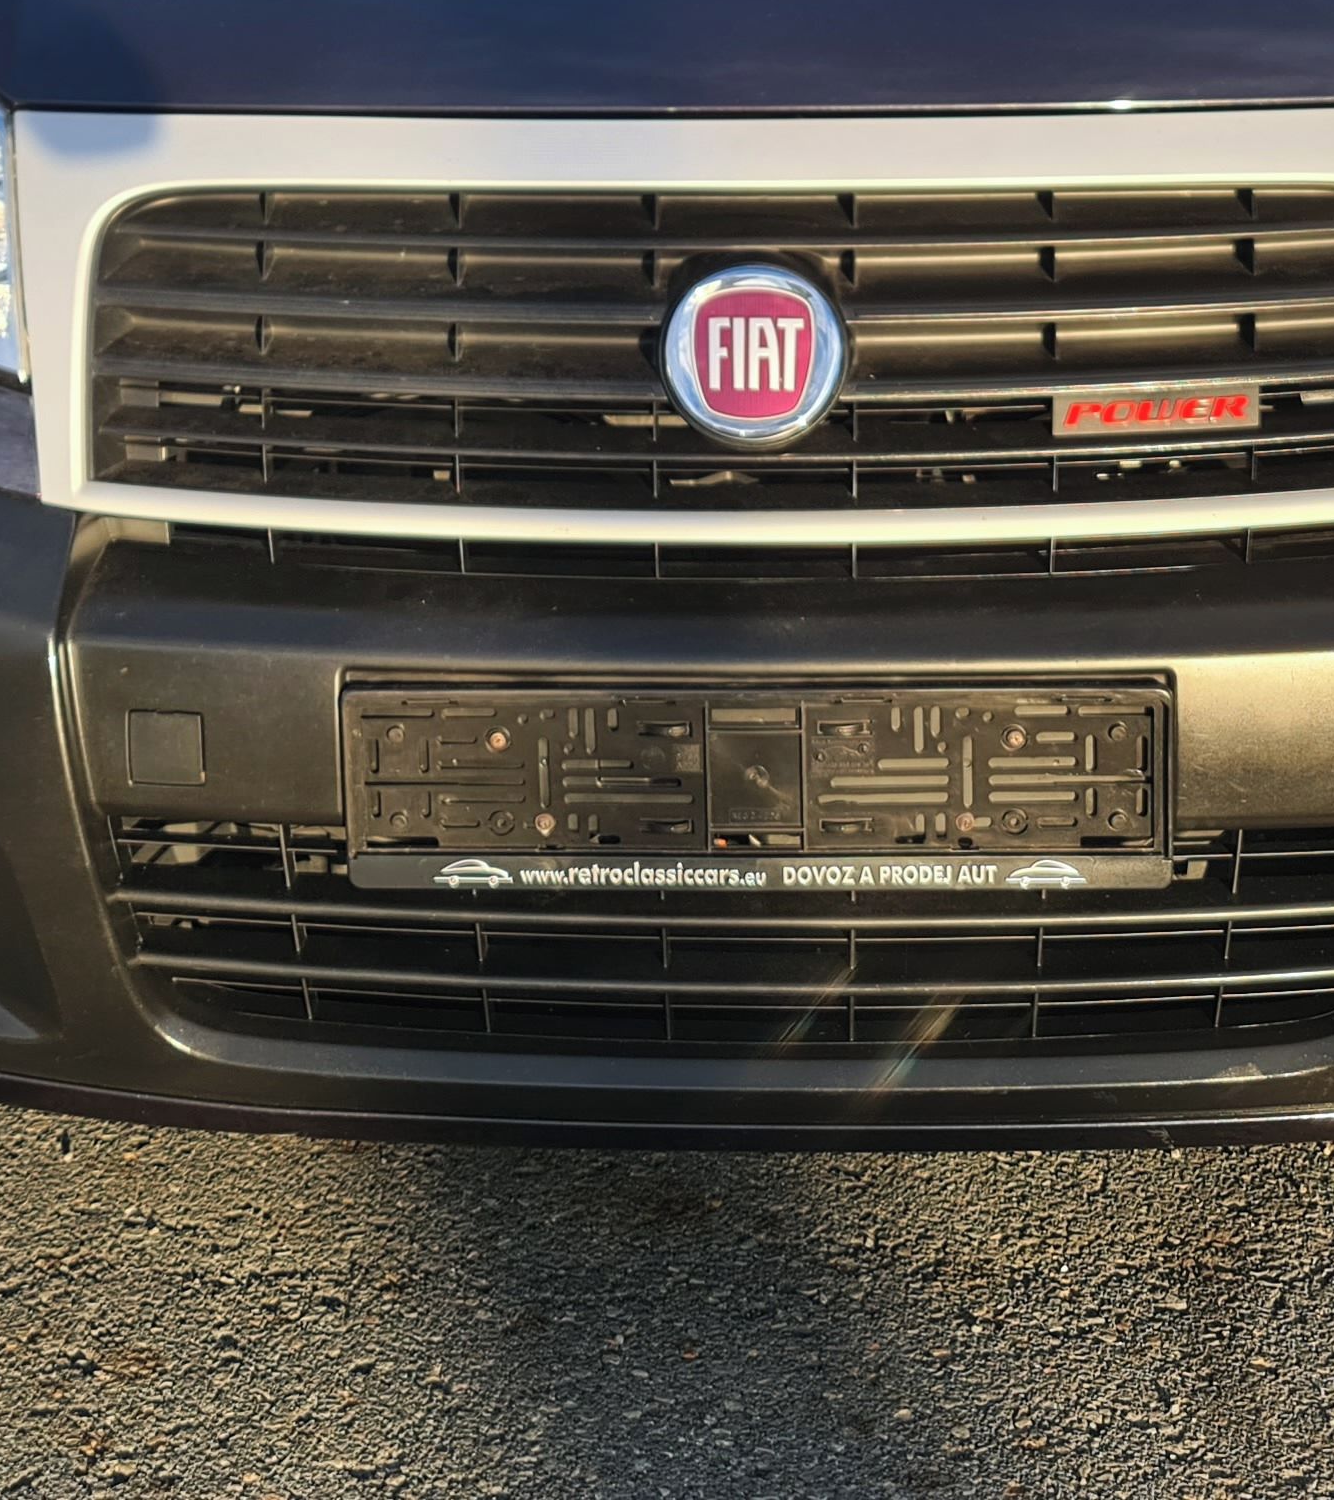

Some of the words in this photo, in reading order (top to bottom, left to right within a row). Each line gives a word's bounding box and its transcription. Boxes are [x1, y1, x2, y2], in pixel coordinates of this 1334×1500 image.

[707, 315, 805, 394] FIAT
[1062, 393, 1251, 428] POWER
[519, 861, 767, 887] www.retroclassiccars.eu
[782, 865, 856, 886] DOVOZ
[859, 865, 875, 885] A
[879, 864, 953, 886] PRODEJ
[957, 864, 999, 884] AUT
